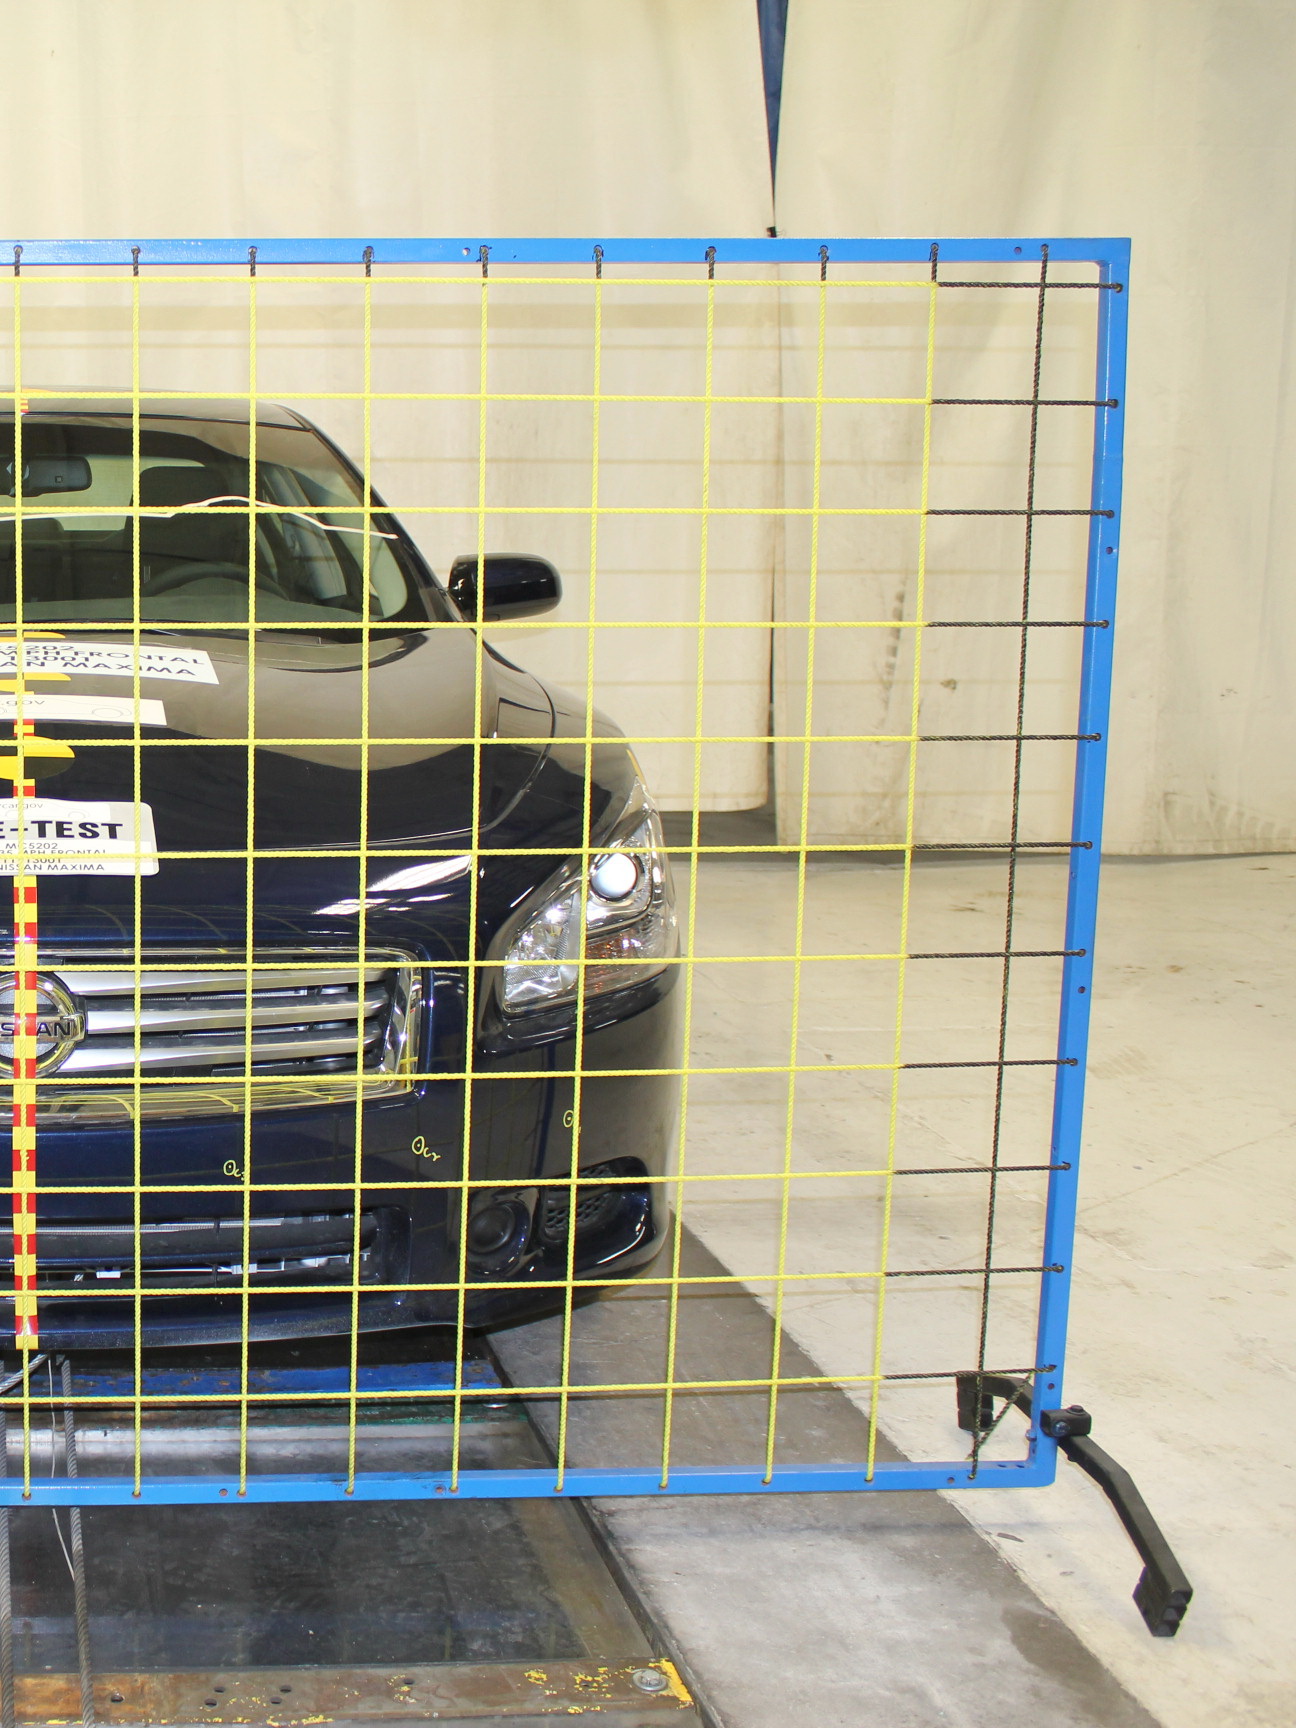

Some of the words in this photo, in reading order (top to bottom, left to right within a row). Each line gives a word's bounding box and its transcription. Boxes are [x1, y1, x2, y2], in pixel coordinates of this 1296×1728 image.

[74, 651, 205, 665] FRONTAL
[62, 662, 196, 676] MAXIMA
[47, 863, 105, 871] MAXIMA
